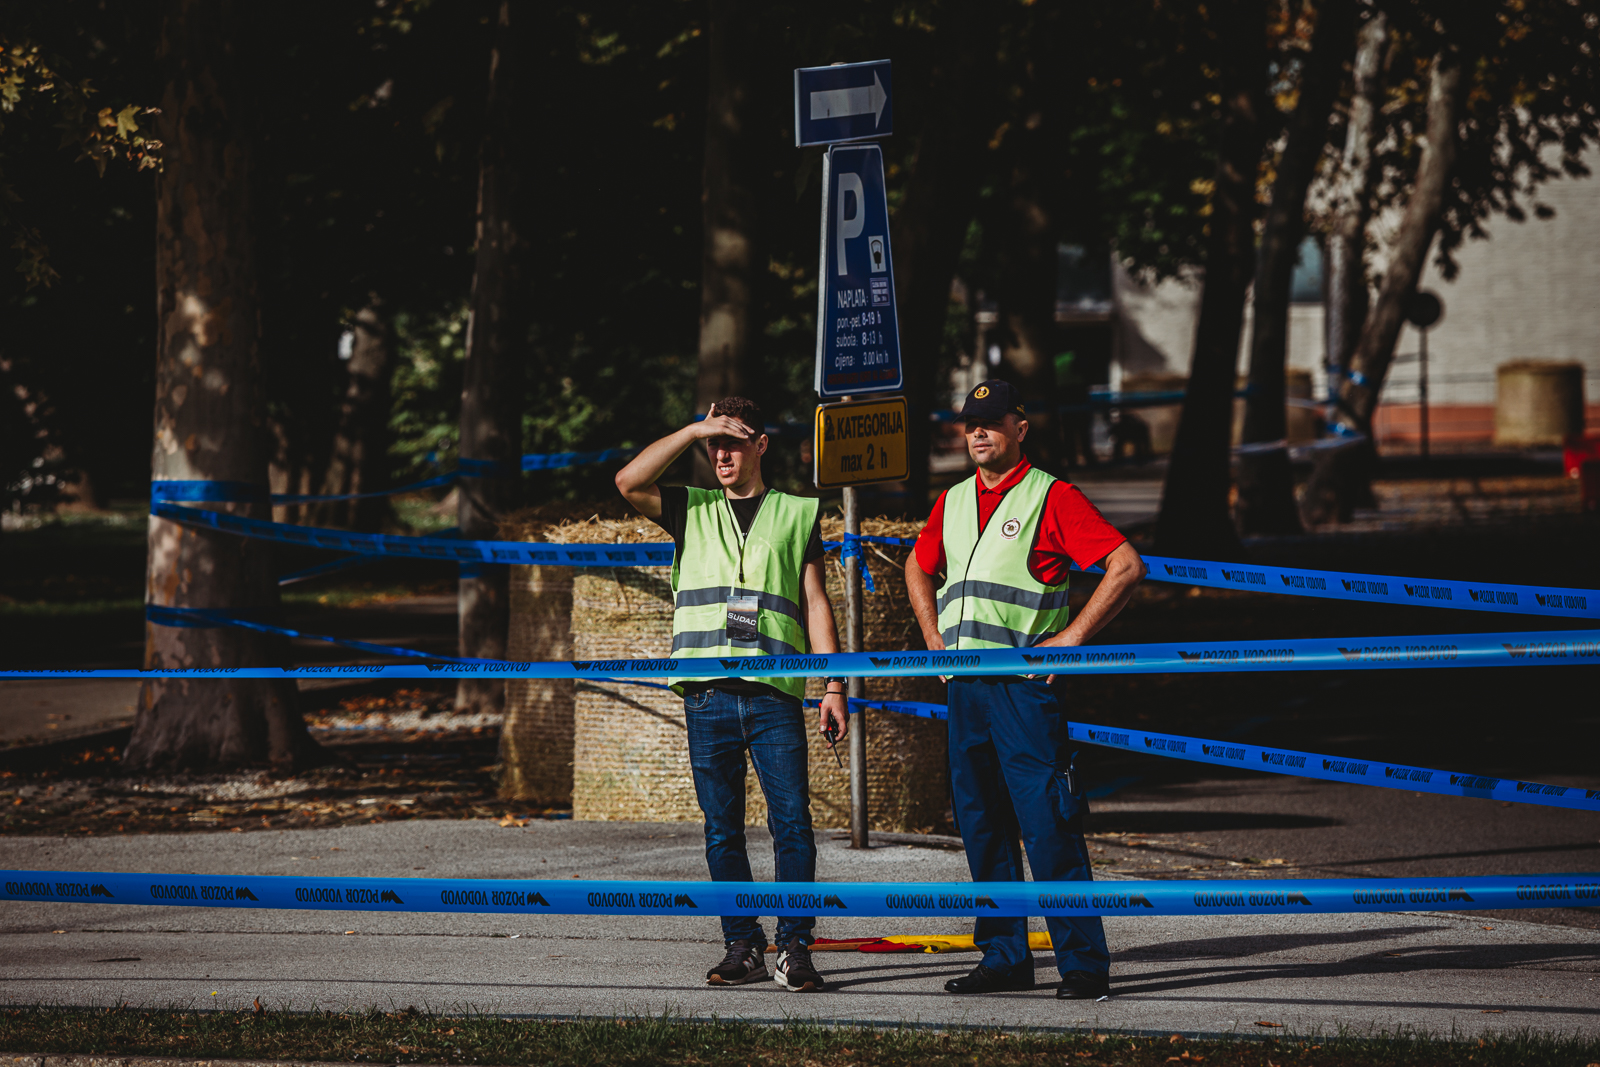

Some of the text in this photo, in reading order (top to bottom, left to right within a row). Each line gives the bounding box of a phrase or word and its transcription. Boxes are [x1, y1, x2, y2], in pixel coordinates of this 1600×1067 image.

[837, 172, 865, 276] P
[837, 411, 904, 440] KATEGORIJA
[841, 443, 887, 473] max 2 h
[727, 612, 756, 626] SUDAC
[1201, 649, 1295, 664] POZOR VODOVOD
[1363, 645, 1458, 661] POZOR VODOVOD
[1529, 642, 1567, 658] POZOR
[444, 663, 531, 672] POZOR VODOVOD
[591, 660, 678, 671] POZOR VODOVOD
[740, 658, 828, 671] POZOR VODOVOD
[892, 655, 980, 669] POZOR VODOVOD
[1045, 652, 1136, 667] POZOR VODOVOD
[6, 882, 90, 897] POZOR VODOVOD
[151, 884, 234, 900] POZOR VODOVOD
[295, 888, 379, 903] POZOR VODOVOD
[1353, 887, 1447, 904] POZOR VODOVOD
[1516, 883, 1600, 900] ZOR VODOVOD
[441, 890, 525, 906] POZOR VODOVOD
[588, 892, 673, 907] POZOR VODOVOD
[736, 893, 822, 909] POZOR VODOVOD
[886, 894, 973, 909] POZOR VODOVOD
[1038, 893, 1128, 909] POZOR VODOVOD
[1194, 890, 1285, 907] POZOR VODOVOD
